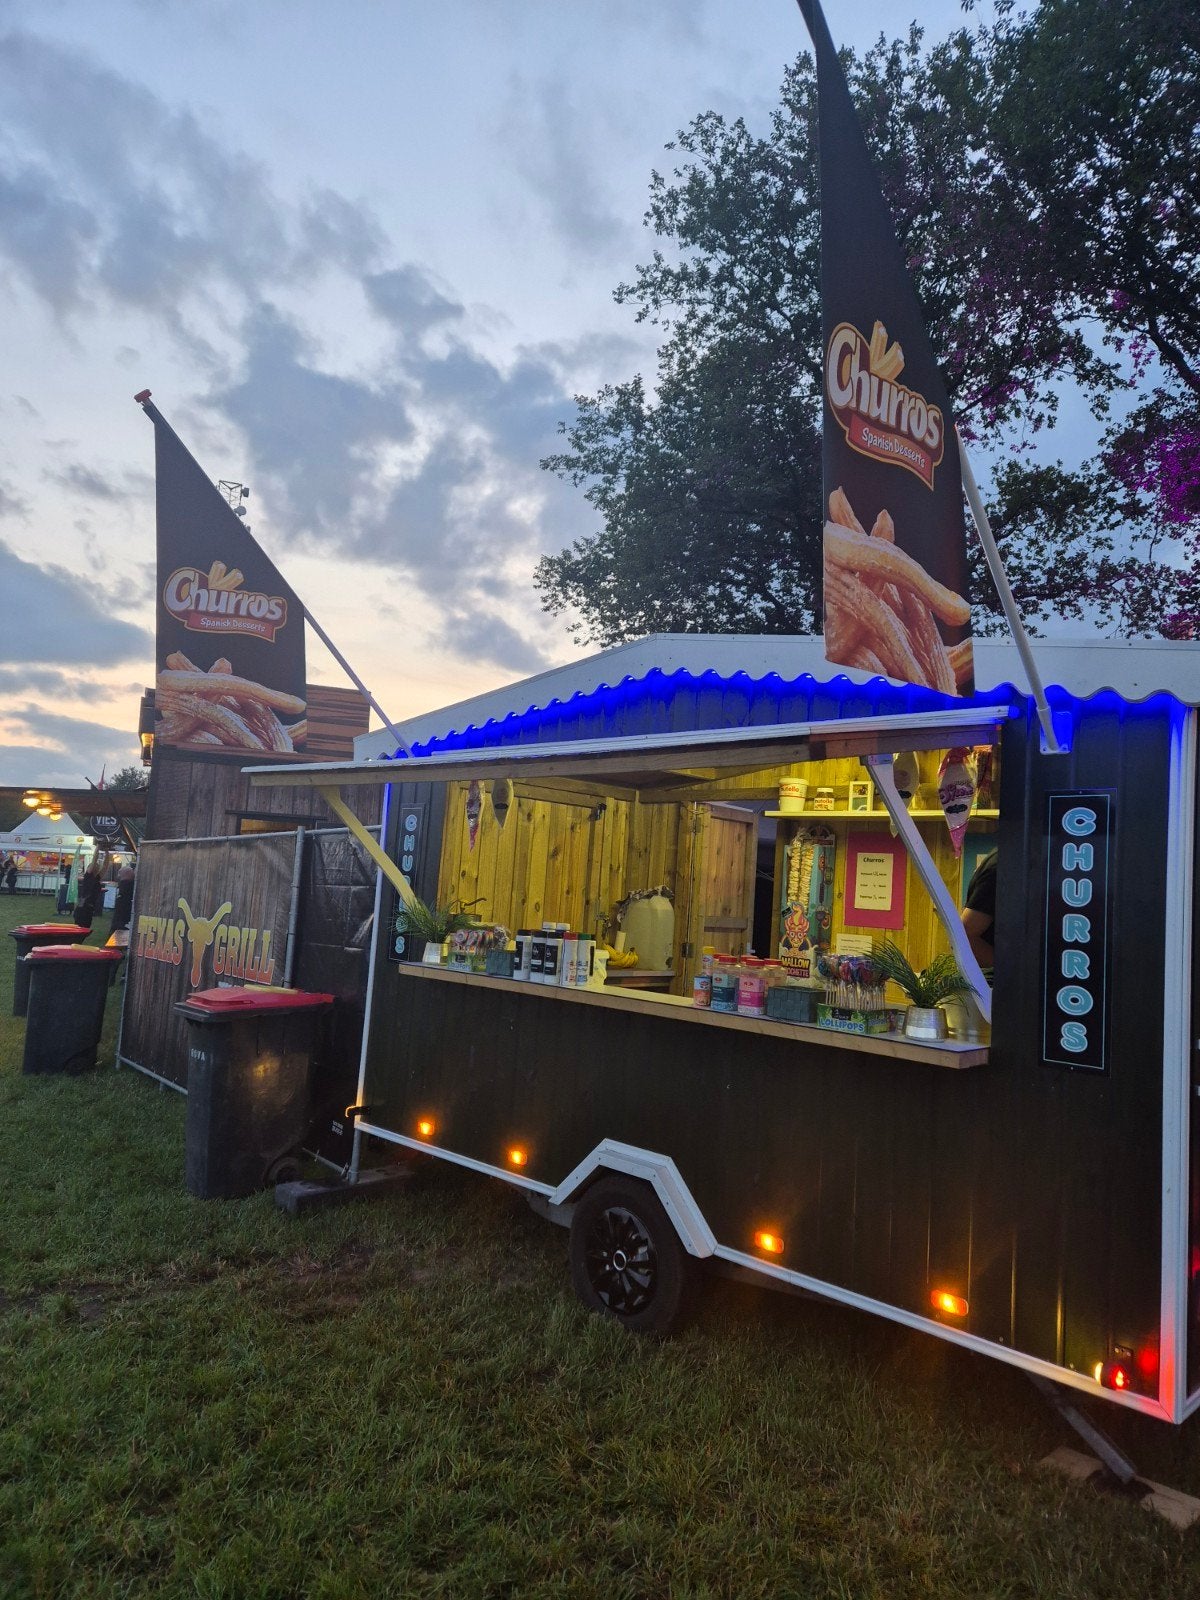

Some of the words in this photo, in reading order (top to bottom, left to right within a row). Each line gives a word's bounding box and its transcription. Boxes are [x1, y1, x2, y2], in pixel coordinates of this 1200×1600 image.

[828, 328, 940, 448] Churros
[861, 427, 893, 453] Spanish
[894, 438, 926, 468] Desserts
[165, 570, 283, 621] Churros
[200, 617, 231, 628] Spanish
[233, 620, 266, 632] Desserts
[137, 914, 186, 966] TEXAS
[213, 924, 276, 986] GRILL
[1056, 807, 1097, 1053] CHURROS
[820, 1018, 865, 1032] LOLLIPOPS
